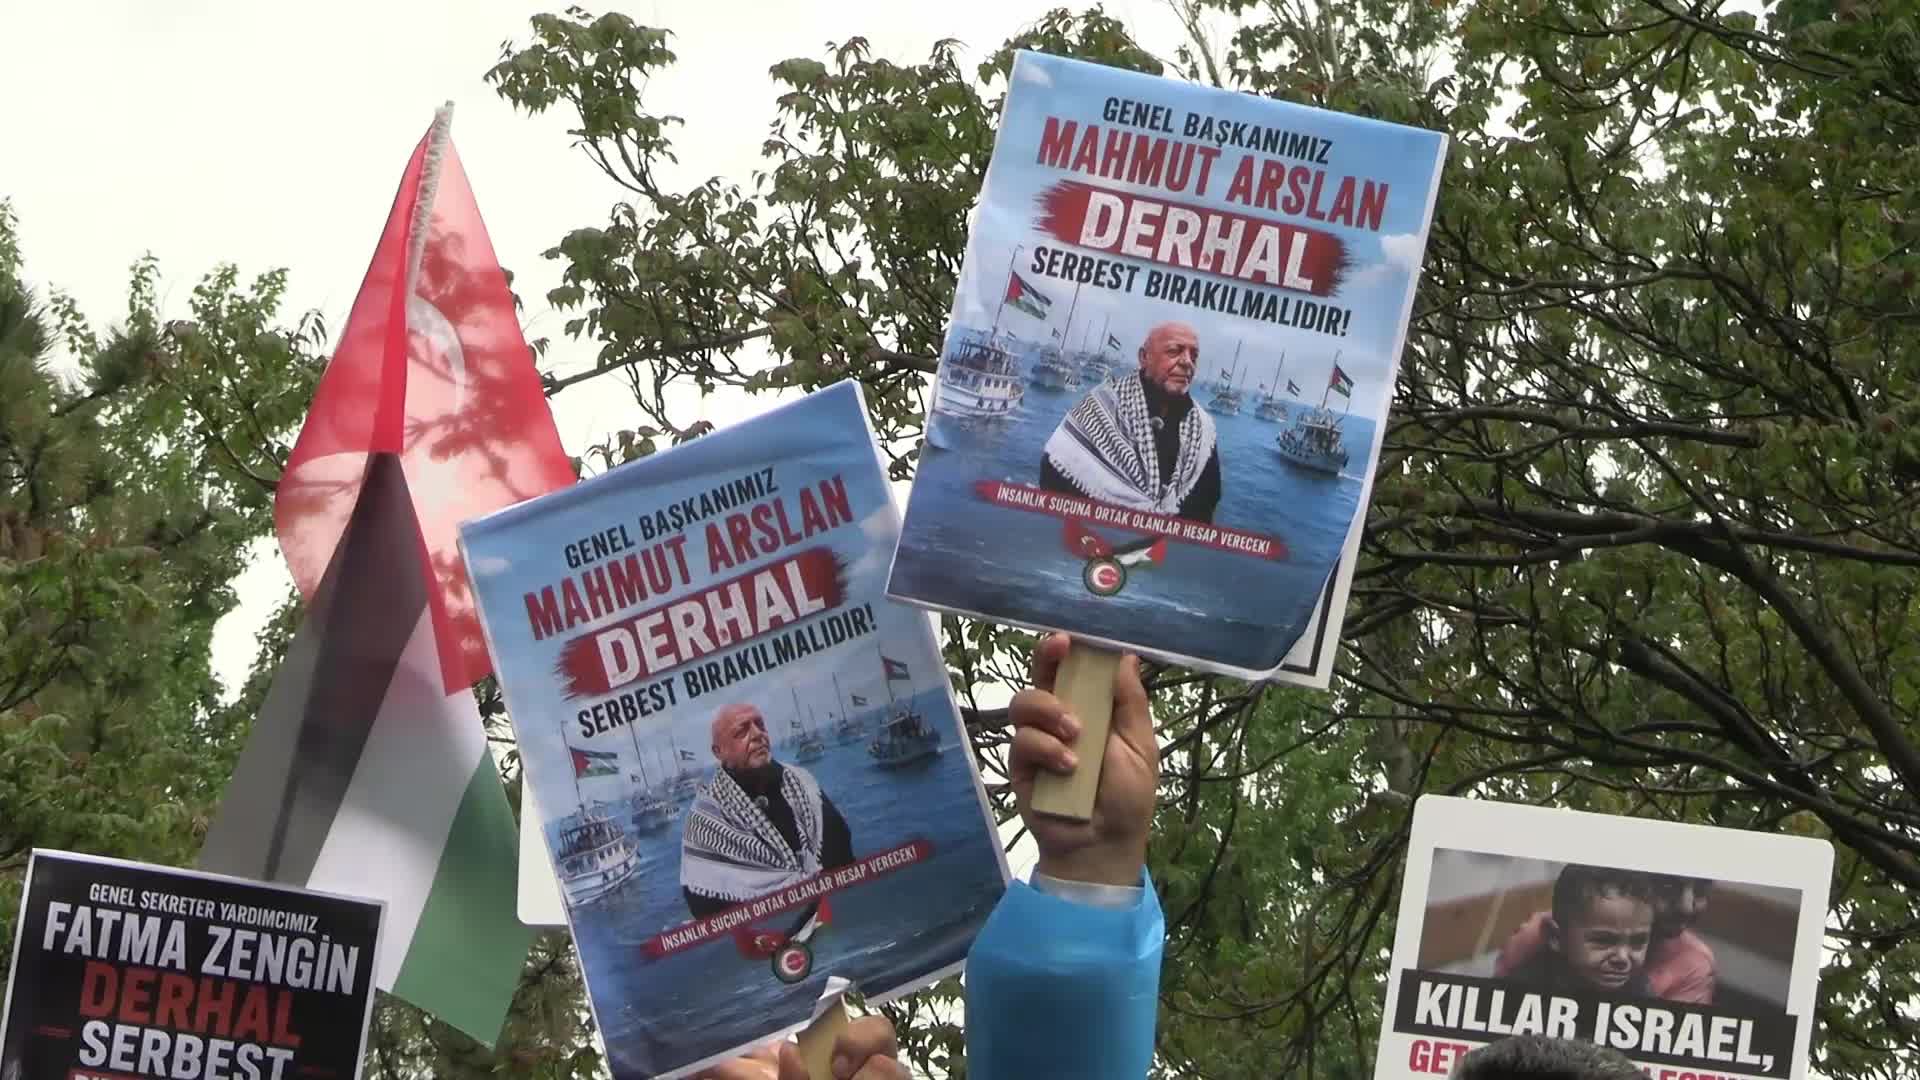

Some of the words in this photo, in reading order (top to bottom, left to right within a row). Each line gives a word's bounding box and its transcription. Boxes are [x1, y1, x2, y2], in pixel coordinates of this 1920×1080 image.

[1036, 116, 1221, 196] MAHMUT
[1225, 155, 1389, 232] ARSLAN
[1103, 97, 1174, 133] GENEL
[1184, 110, 1333, 165] BAŞKANIMIZ
[1079, 191, 1314, 291] DERHAL
[1031, 246, 1140, 293] SERBEST
[1144, 268, 1351, 337] BIRAKILMALIDIR!
[523, 534, 691, 641] MAHMUT
[706, 474, 854, 573] ARSLAN
[565, 523, 636, 569] GENEL
[639, 467, 779, 541] BAŞKANIMIZ
[997, 486, 1046, 508] İNSANLIK
[1050, 496, 1091, 517] SUÇUNA
[1095, 508, 1129, 526] ORTAK
[1132, 515, 1181, 536] OLANLAR
[1183, 525, 1218, 545] HESAP
[1220, 531, 1271, 554] VERECEK!
[577, 677, 678, 739] SERBEST
[682, 603, 879, 698] BIRAKILMALIDIR!
[594, 560, 826, 689] DERHAL
[42, 901, 187, 971] FATMA
[201, 925, 360, 996] ZENGİN
[89, 883, 136, 908] GENEL
[139, 891, 215, 920] SEKRETER
[219, 902, 319, 934] YARDIMCIMIZ
[661, 921, 708, 951] İNSANLIK
[711, 907, 752, 932] SUÇUNA
[753, 893, 786, 917] ORTAK
[789, 875, 833, 904] OLANLAR
[835, 864, 867, 886] HESAP
[79, 961, 303, 1046] DERHAL
[79, 1020, 295, 1080] SERBEST
[1414, 980, 1579, 1041] KILLAR
[1593, 1002, 1774, 1073] ISRAEL,
